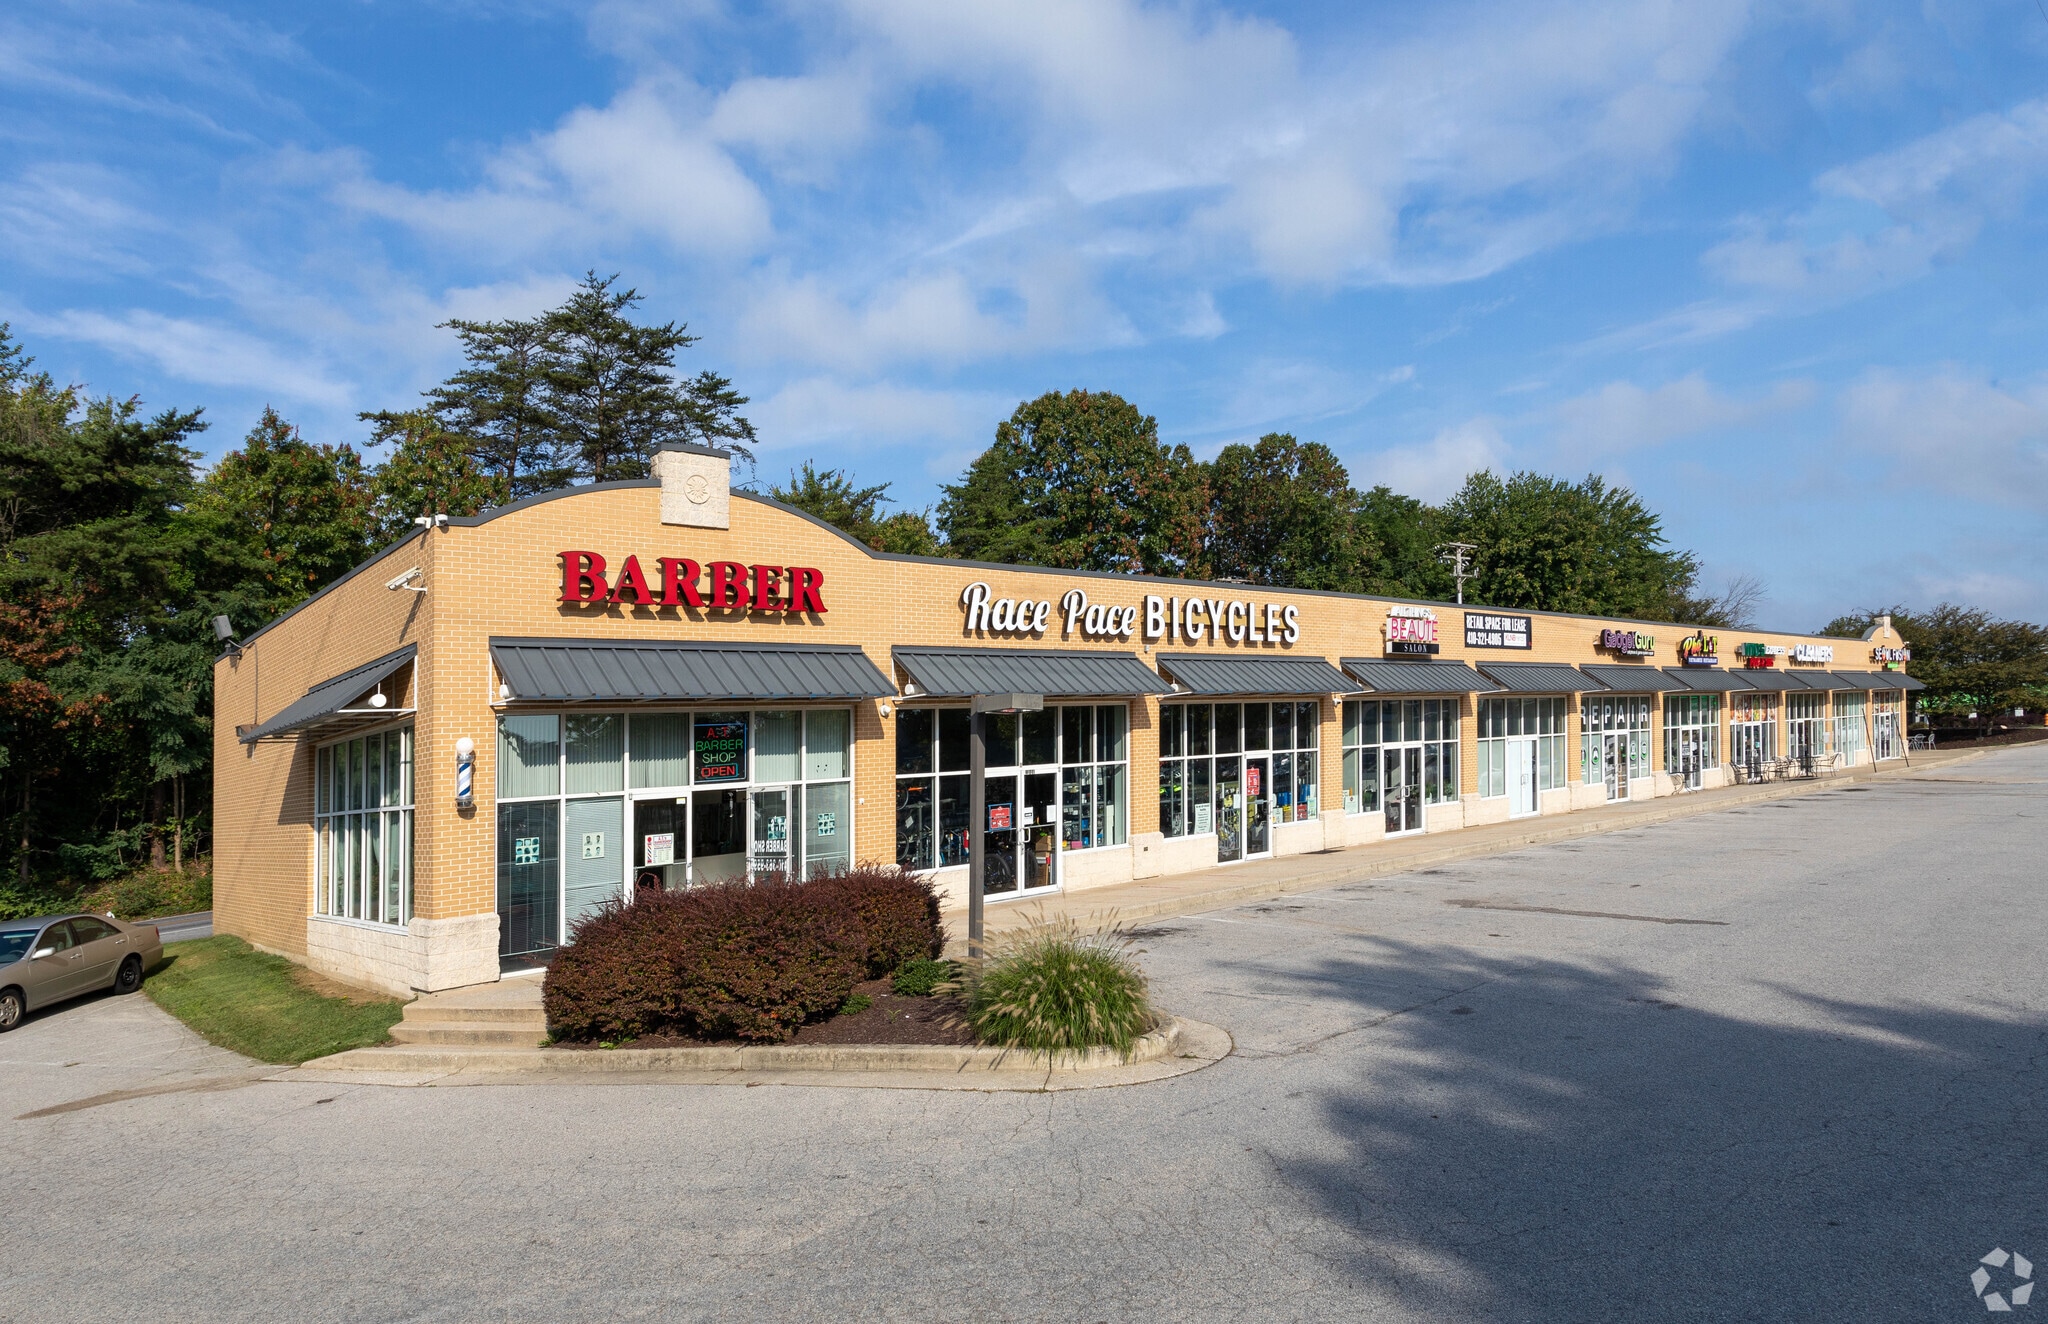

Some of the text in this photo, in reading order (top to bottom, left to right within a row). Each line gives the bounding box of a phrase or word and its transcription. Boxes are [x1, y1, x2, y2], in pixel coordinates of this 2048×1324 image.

[556, 551, 829, 613] BARBER
[962, 581, 1300, 644] Race Pace BICYCLES
[1466, 615, 1526, 632] RETAIL SPACE FOR LEASE
[1403, 643, 1428, 653] SALON
[1581, 704, 1648, 725] REPAIR
[695, 738, 743, 752] BARBER
[702, 751, 737, 764] SHOP
[701, 765, 736, 778] OPEN
